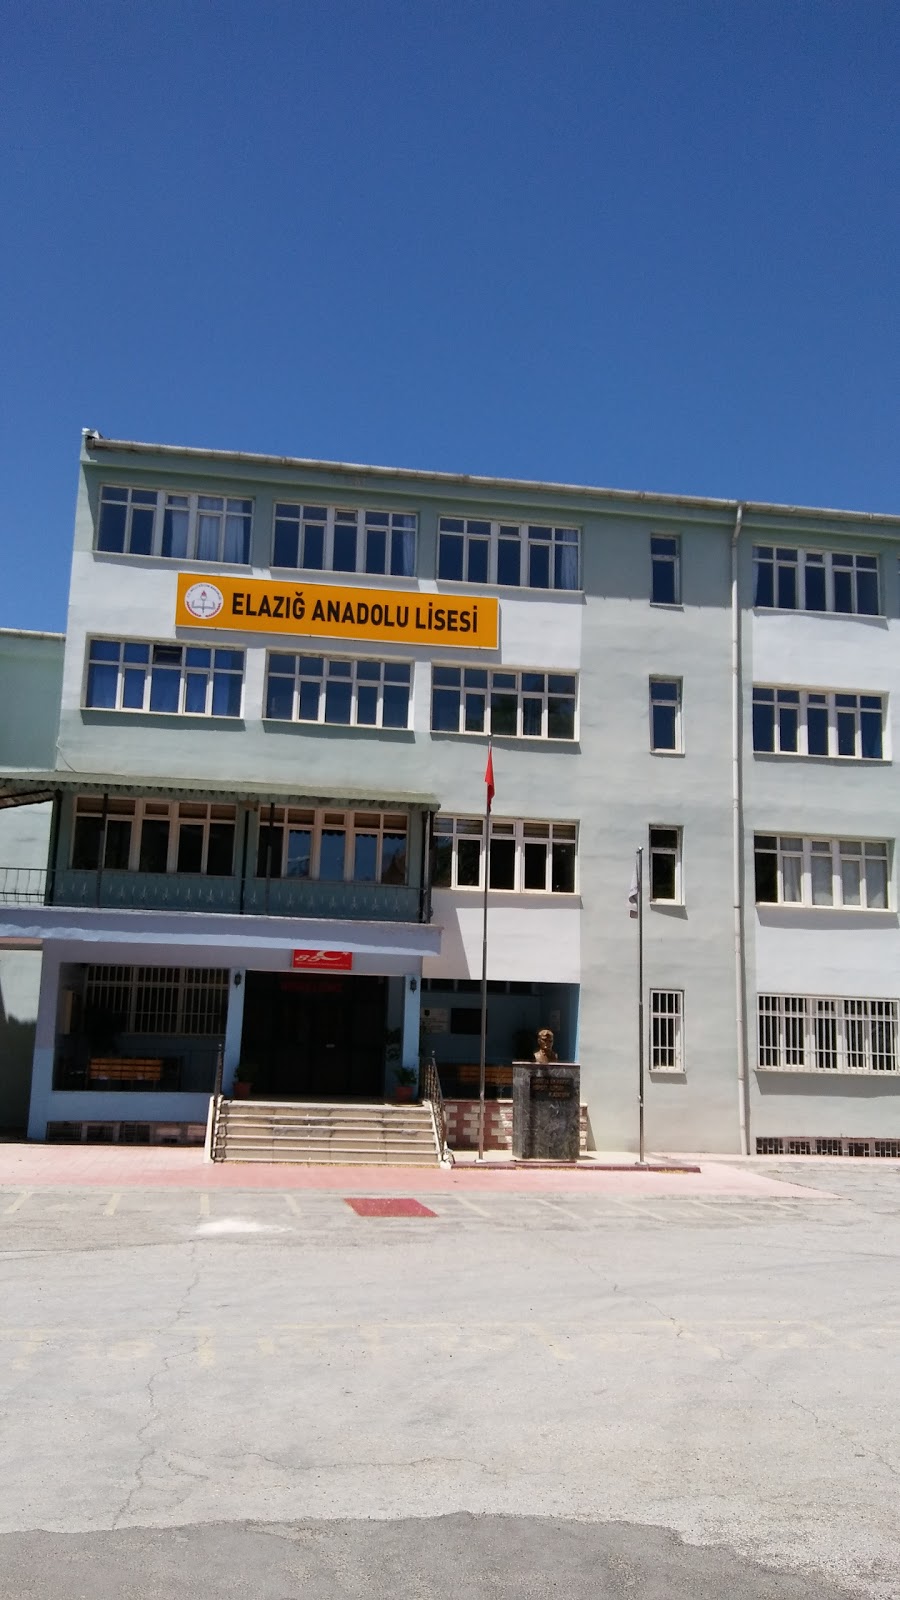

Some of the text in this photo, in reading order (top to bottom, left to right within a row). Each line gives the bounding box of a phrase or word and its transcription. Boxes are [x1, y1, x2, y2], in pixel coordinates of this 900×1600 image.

[231, 591, 306, 620] ELAZIĞ
[311, 599, 409, 628] ANADOLU
[415, 601, 478, 633] LİSESİ
